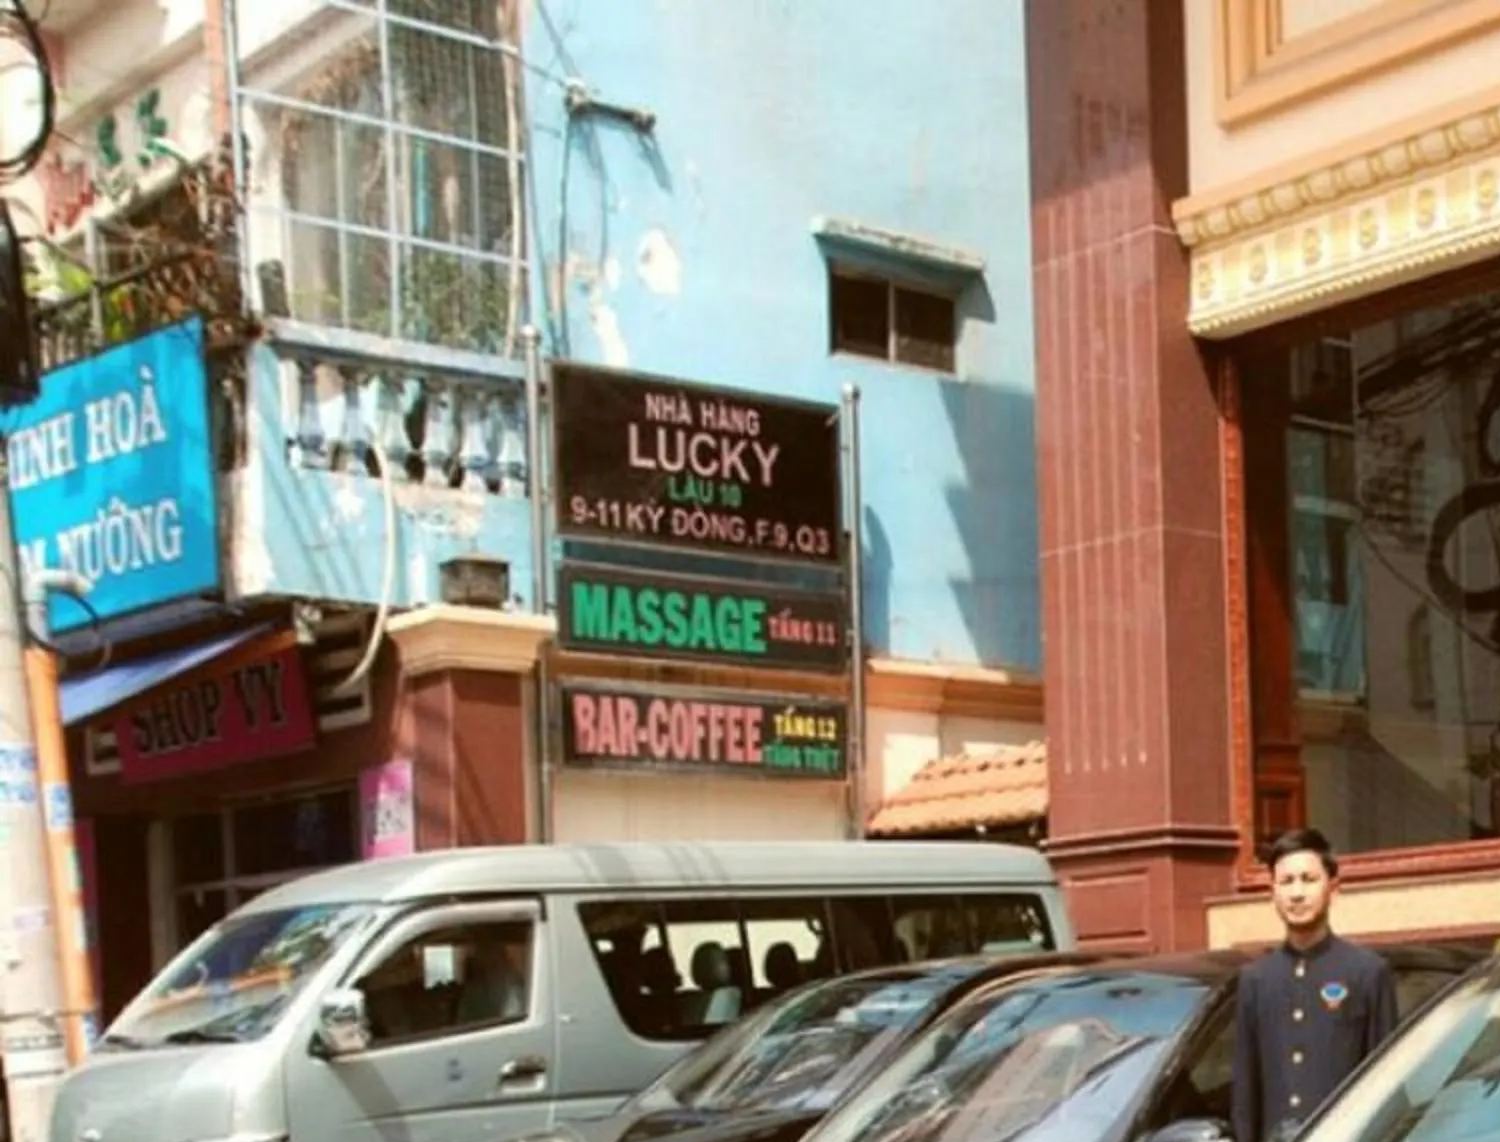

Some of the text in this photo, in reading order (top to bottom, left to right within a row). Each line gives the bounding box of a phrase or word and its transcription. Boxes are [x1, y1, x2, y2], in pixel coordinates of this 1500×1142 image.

[8, 365, 167, 491] INH HOÀ
[645, 391, 760, 436] NHÀ HÀNG
[628, 423, 780, 486] LUCKY
[571, 582, 768, 653] MASSAGE
[131, 660, 288, 757] SHOP VY
[572, 693, 765, 762] BAR-COFFEE
